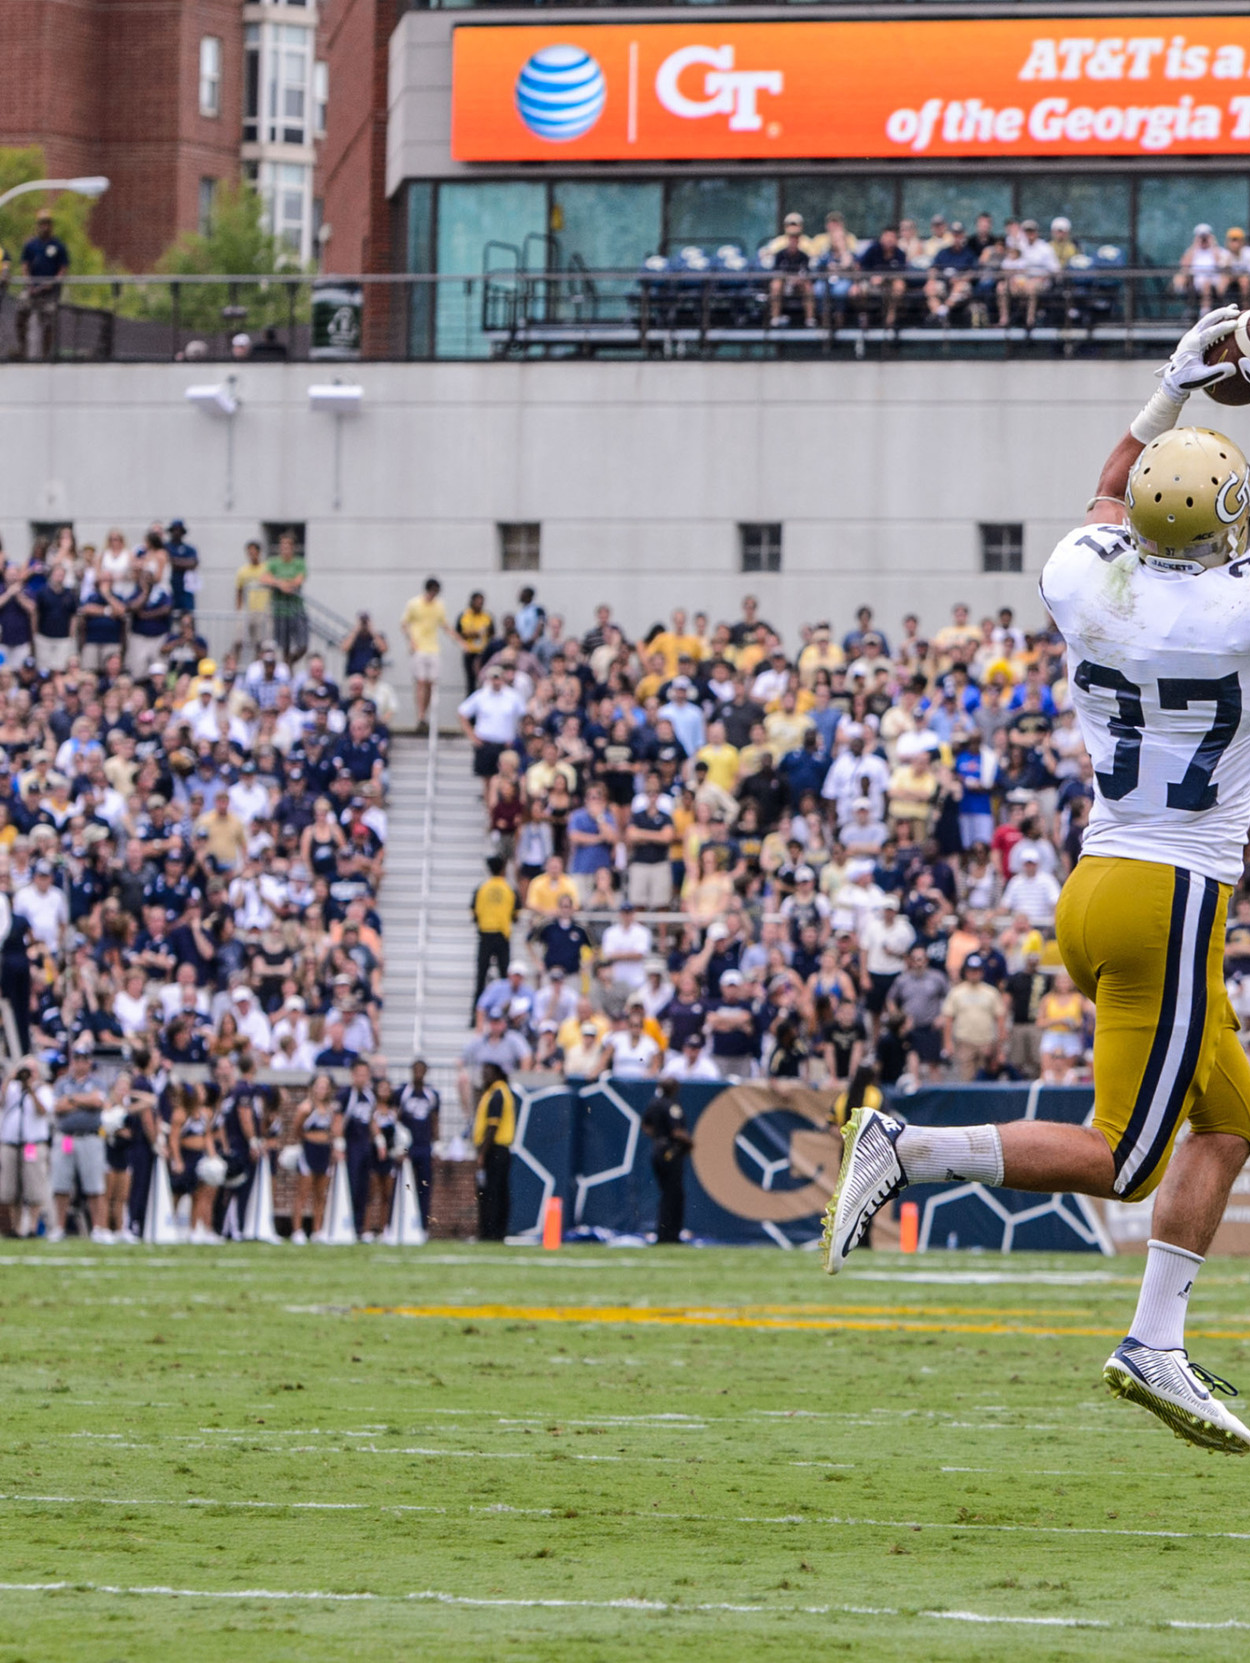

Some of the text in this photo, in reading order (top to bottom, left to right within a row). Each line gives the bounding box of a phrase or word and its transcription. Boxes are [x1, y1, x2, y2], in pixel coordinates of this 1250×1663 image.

[1018, 37, 1164, 80] AT&T
[1165, 36, 1209, 79] is
[1212, 45, 1245, 78] a
[886, 97, 943, 150] of
[942, 98, 1024, 141] the
[1028, 96, 1221, 149] Georgia
[1192, 531, 1215, 541] ACC
[1165, 547, 1176, 556] 37
[1152, 560, 1193, 571] JACKETS
[1074, 660, 1242, 811] 37
